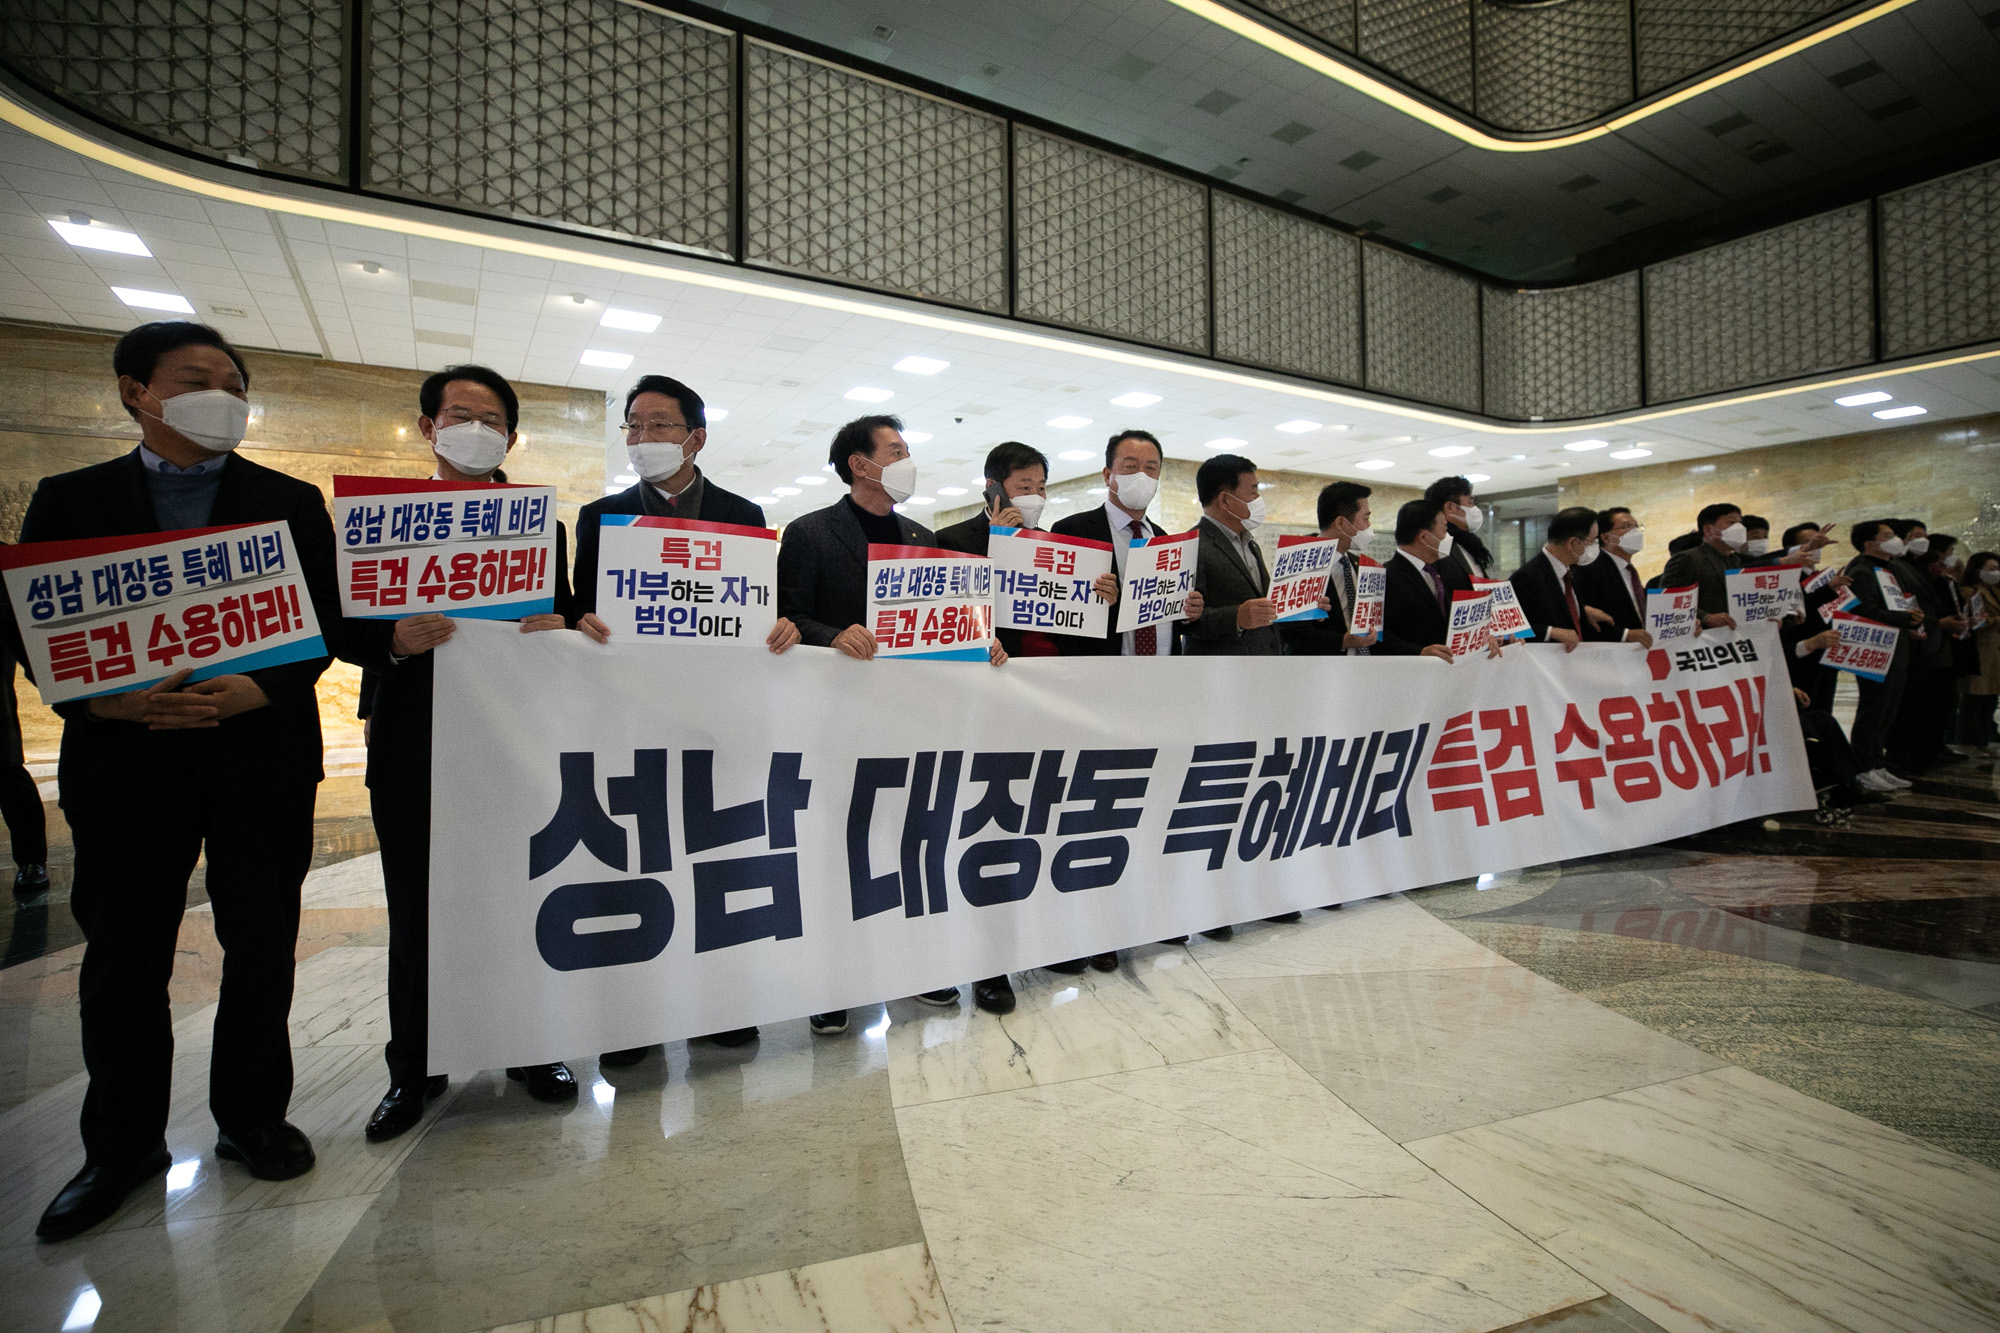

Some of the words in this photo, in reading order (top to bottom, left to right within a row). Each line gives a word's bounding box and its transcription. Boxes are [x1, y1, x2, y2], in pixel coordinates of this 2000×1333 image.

[345, 504, 386, 545] 성남
[391, 501, 454, 543] 대장동
[461, 498, 503, 537] 특혜
[508, 495, 548, 534] 비리
[660, 537, 722, 571] 특검
[1033, 546, 1076, 575] 특검
[1155, 546, 1182, 572] 특검
[1274, 551, 1291, 578] 성남
[1287, 549, 1308, 574] 대장동
[1305, 546, 1322, 570] 특혜
[27, 569, 84, 621] 성남
[92, 554, 173, 607] 대장동
[182, 541, 233, 587] 특혜
[237, 530, 286, 576] 비리
[351, 557, 409, 607] 특검
[417, 547, 548, 603] 수용하라!
[607, 568, 715, 603] 거부하는
[720, 576, 770, 606] 자가
[875, 566, 905, 599] 성남
[907, 566, 947, 597] 대장동
[950, 565, 971, 595] 특혜
[974, 565, 991, 594] 비리
[994, 569, 1068, 601] 거부하는
[1129, 576, 1176, 601] 거부하는
[1754, 574, 1780, 589] 특검
[1012, 599, 1084, 629] 범인이다
[1137, 598, 1185, 625] 범인이다
[1271, 583, 1289, 614] 특검
[1673, 594, 1693, 610] 특검
[1732, 592, 1776, 607] 거부하는
[48, 621, 136, 684] 특검
[147, 584, 304, 667] 수용하라!
[635, 605, 742, 638] 범인이다
[875, 608, 918, 648] 특검
[921, 604, 991, 646] 수용하라!
[1651, 612, 1687, 628] 거부하는
[1675, 638, 1759, 672] 국민의힘
[529, 748, 813, 972] 성남
[846, 748, 1158, 922] 대장동
[1163, 722, 1430, 872] 특혜비리
[1427, 704, 1545, 827] 특검
[1554, 674, 1773, 811] 수용하라!
